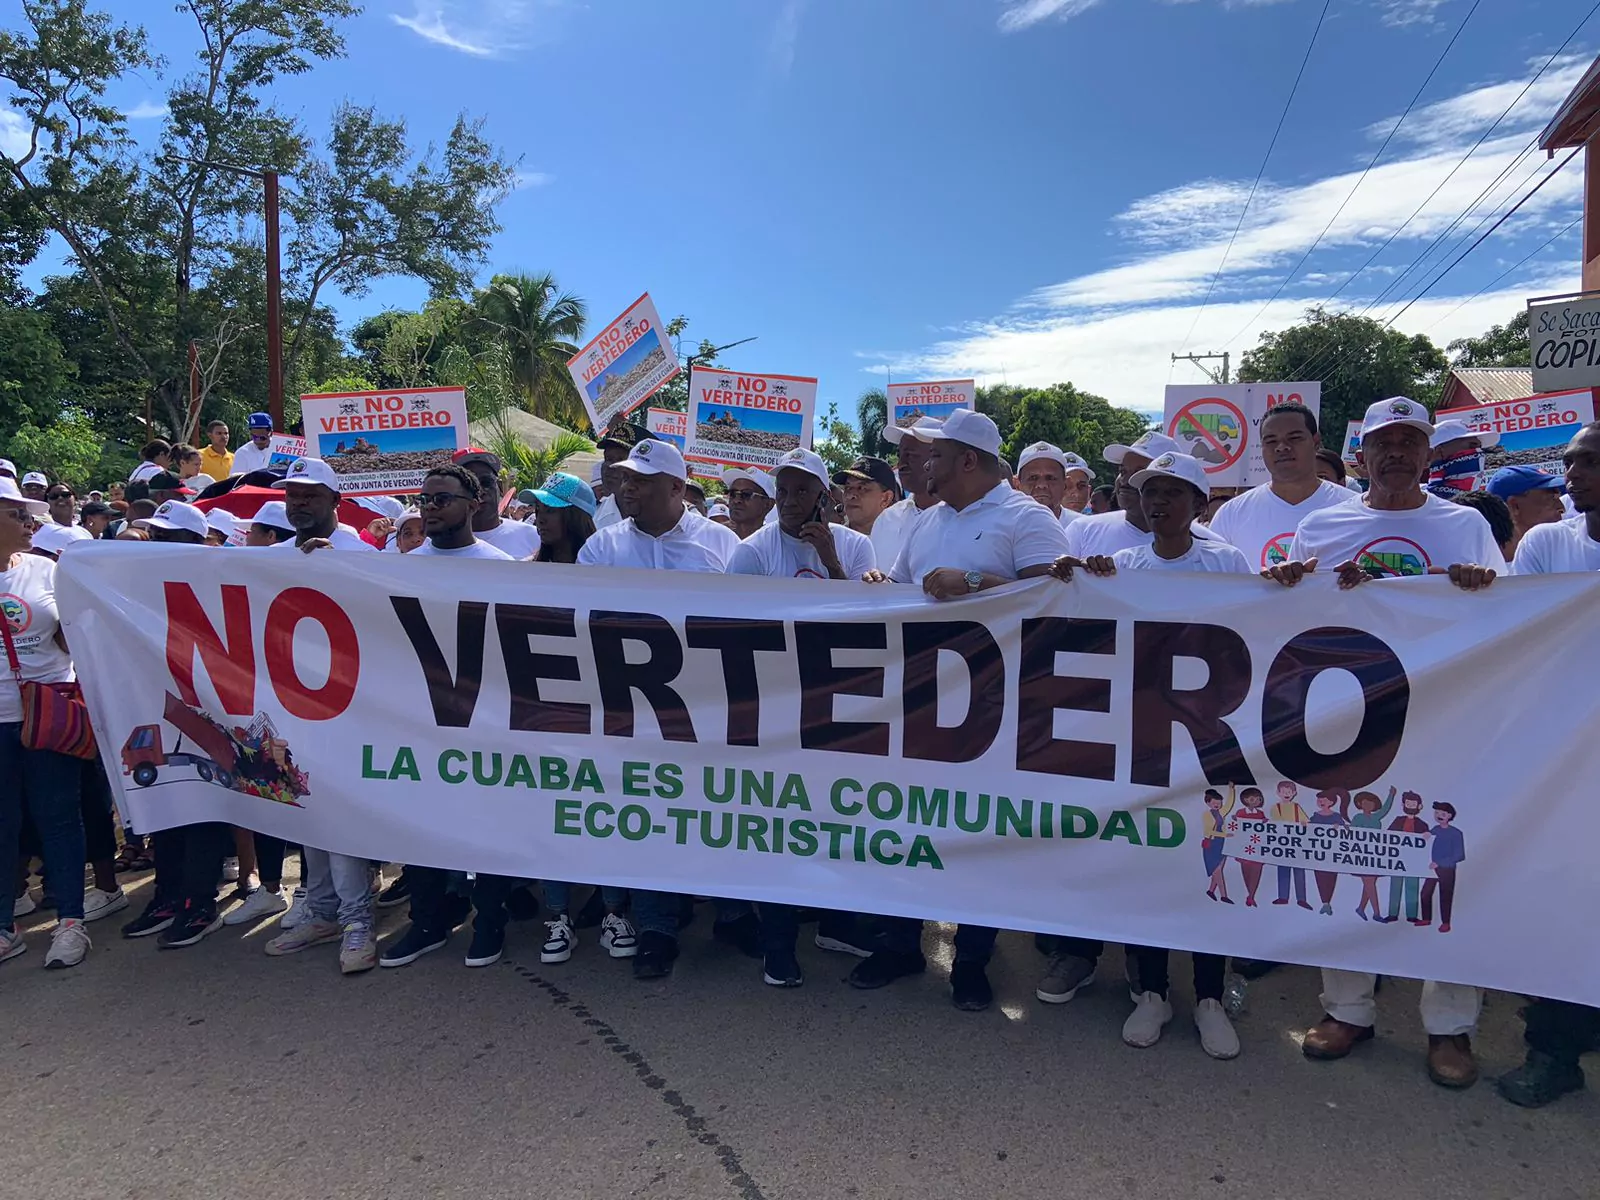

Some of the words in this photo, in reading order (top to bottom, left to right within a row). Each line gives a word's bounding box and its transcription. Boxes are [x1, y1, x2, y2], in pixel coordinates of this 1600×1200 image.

[1538, 311, 1556, 333] Se
[581, 318, 650, 383] VERTEDERO
[598, 327, 621, 352] NO
[1535, 339, 1600, 369] COPI
[737, 376, 767, 393] NO
[921, 386, 941, 394] NO
[365, 396, 404, 413] NO
[702, 388, 801, 413] VERTEDERO
[896, 393, 966, 405] VERTEDERO
[320, 410, 451, 432] VERTEDERO
[678, 416, 687, 426] N
[1467, 410, 1577, 432] ERTEDERO
[1494, 403, 1531, 419] NO
[655, 423, 687, 436] VERTE
[275, 444, 308, 457] VERTED
[720, 451, 736, 460] JUNTA
[745, 454, 767, 464] VECINOS
[767, 457, 775, 465] DE
[338, 482, 360, 491] ACIÓN
[361, 481, 382, 490] JUNTA
[384, 480, 392, 488] DE
[393, 478, 423, 487] VECINOS
[163, 580, 360, 721] NO
[389, 595, 1410, 790] VERTEDERO
[361, 744, 421, 781] LA
[438, 749, 605, 793] CUABA
[622, 761, 684, 799] ES
[703, 766, 812, 811] UNA
[830, 777, 1186, 848] COMUNIDAD
[554, 799, 944, 870] ECO-TURISTICA
[1242, 822, 1277, 834] POR
[1284, 824, 1307, 836] TU
[1314, 826, 1427, 849] COMUNIDAD
[1266, 835, 1302, 848] POR
[1308, 838, 1332, 850] TU
[1340, 840, 1400, 858] SALUD
[1260, 846, 1296, 859] POR
[1302, 850, 1326, 862] TU
[1333, 853, 1406, 872] FAMILIA
